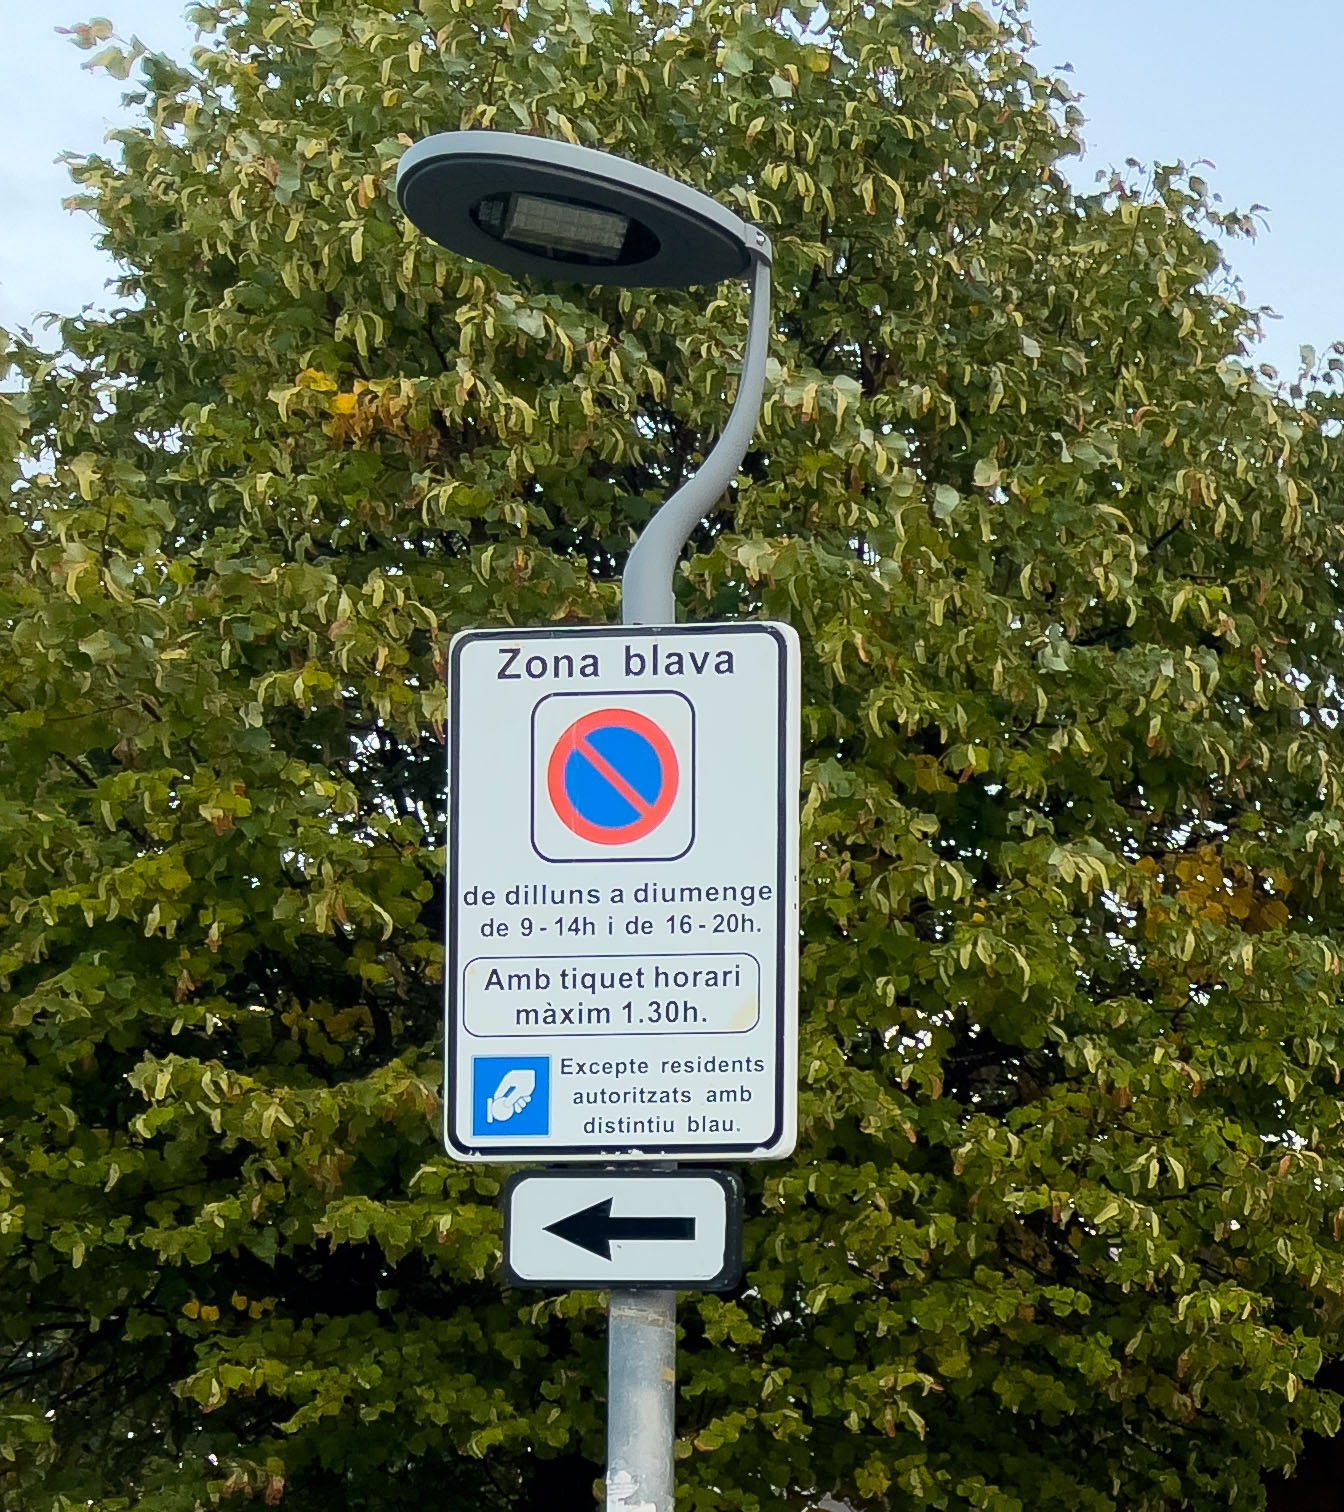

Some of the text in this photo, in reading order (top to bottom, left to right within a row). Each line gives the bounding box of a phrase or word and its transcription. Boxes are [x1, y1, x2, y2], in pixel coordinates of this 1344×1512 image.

[497, 643, 736, 680] Zona blava
[463, 882, 773, 906] de dilluns a diumenge
[480, 917, 509, 937] de
[607, 915, 614, 935] i
[625, 915, 654, 935] de
[484, 964, 741, 995] Amb tiquet horari
[515, 1000, 708, 1026] màxim 1.30h.
[560, 1055, 765, 1079] Excepte residents
[572, 1085, 753, 1105] autoritzats amb
[583, 1115, 741, 1134] distintiu blau.
